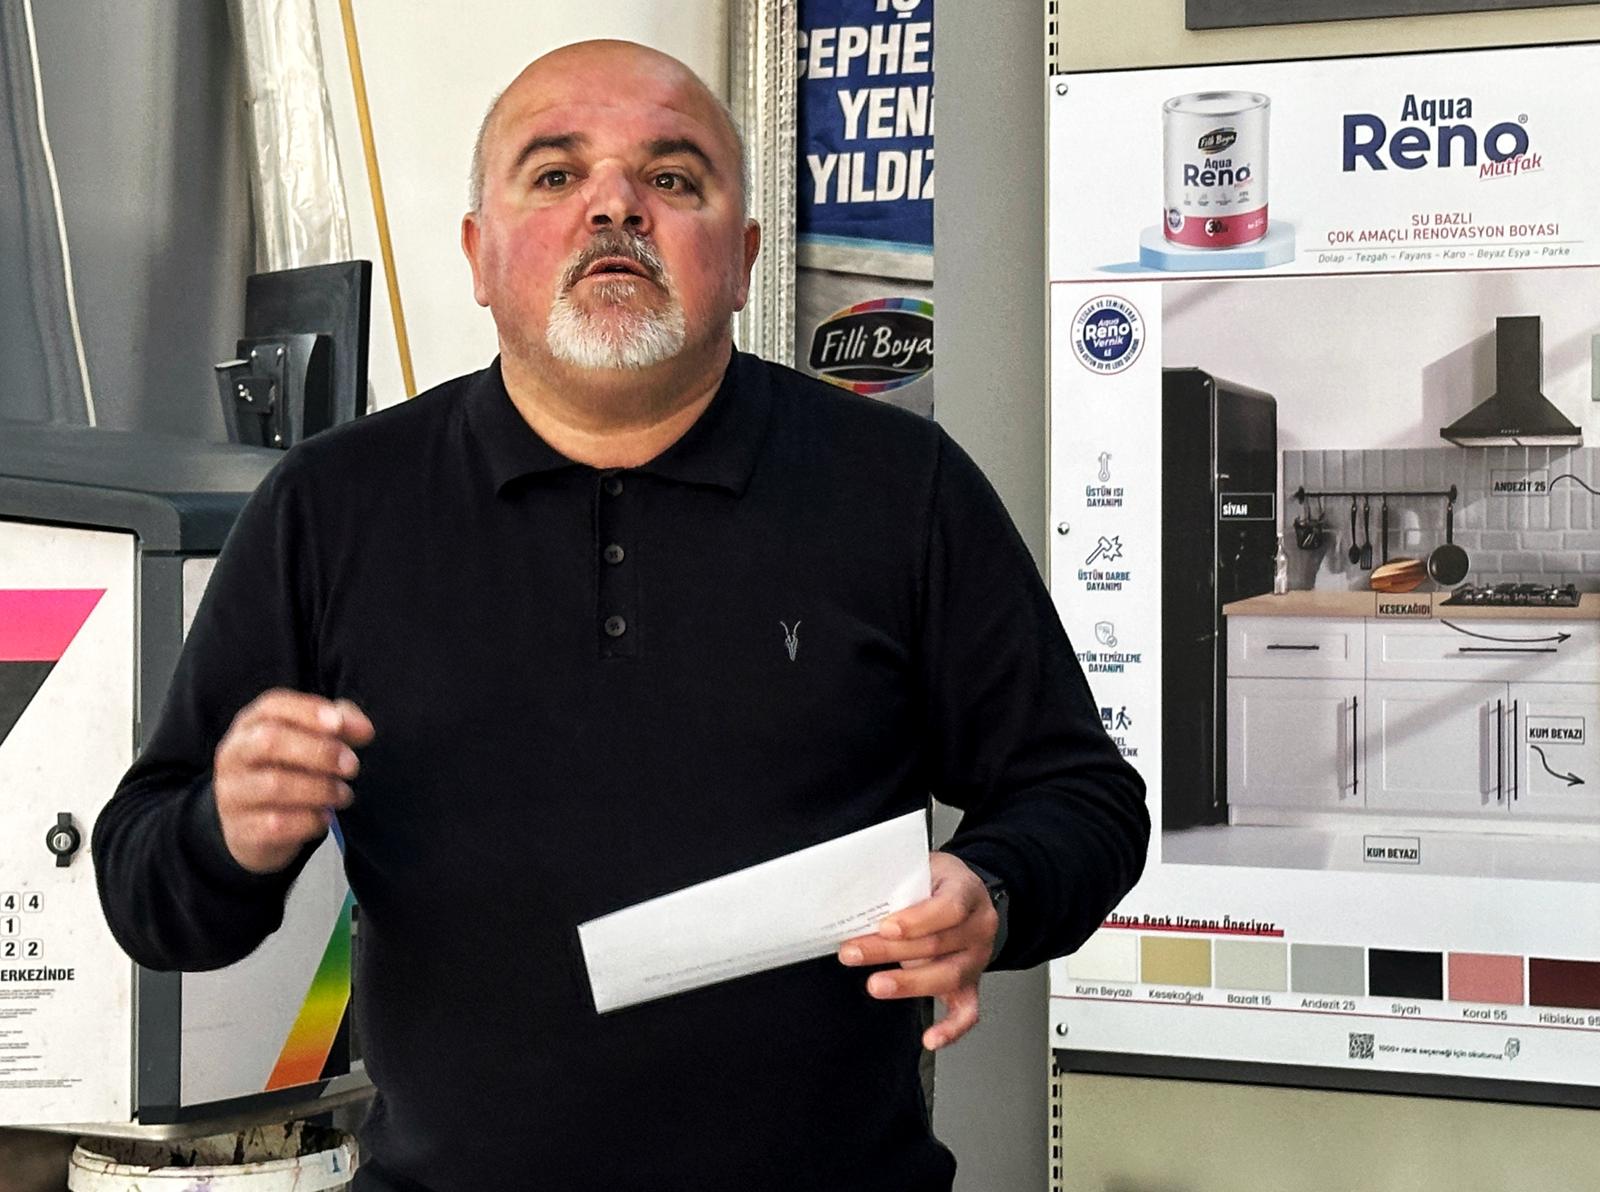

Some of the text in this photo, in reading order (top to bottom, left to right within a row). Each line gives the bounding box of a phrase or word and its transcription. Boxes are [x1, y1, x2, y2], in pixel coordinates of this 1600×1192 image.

[1400, 94, 1473, 126] Aqua
[1342, 113, 1529, 172] Reno
[1204, 157, 1233, 171] Aqua
[1479, 153, 1543, 178] Mutfak
[1183, 163, 1251, 187] Reno
[1411, 212, 1473, 226] SU BAZLI
[1327, 223, 1560, 246] ÇOK AMAÇLI RENOVASYON BOYASI
[1318, 246, 1571, 264] Dolap Tezgah Fayans Karo Beyaz Eşya Parke
[1085, 322, 1130, 341] Reno
[820, 325, 934, 368] Filli Boya
[1086, 485, 1111, 497] ÜSTÜN
[1494, 478, 1546, 492] ANDEZİT 25
[1222, 502, 1248, 516] SİYAH
[1078, 569, 1131, 581] ÜSTÜN DARBE
[1379, 603, 1430, 615] KESEKAĞIDI
[1076, 650, 1142, 663] STÜN TEMİZLEME
[1529, 727, 1583, 740] KUM BEYAZI
[1366, 847, 1418, 860] KUM BEYAZI
[1111, 912, 1140, 928] Boya
[1143, 913, 1172, 927] Renk
[1176, 915, 1220, 929] Uzmanı
[1223, 914, 1276, 935] Öneriyor
[0, 965, 75, 981] ERKEZİNDE
[1075, 985, 1133, 999] Kum Beyazı
[1148, 989, 1204, 1004] Kesekağıdı
[1227, 994, 1272, 1006] Bazalt 15
[1301, 998, 1356, 1011] Andezit 25
[1391, 1003, 1422, 1017] Siyah
[1462, 1008, 1508, 1021] Koral 55
[1539, 1012, 1585, 1026] Hibiskus
